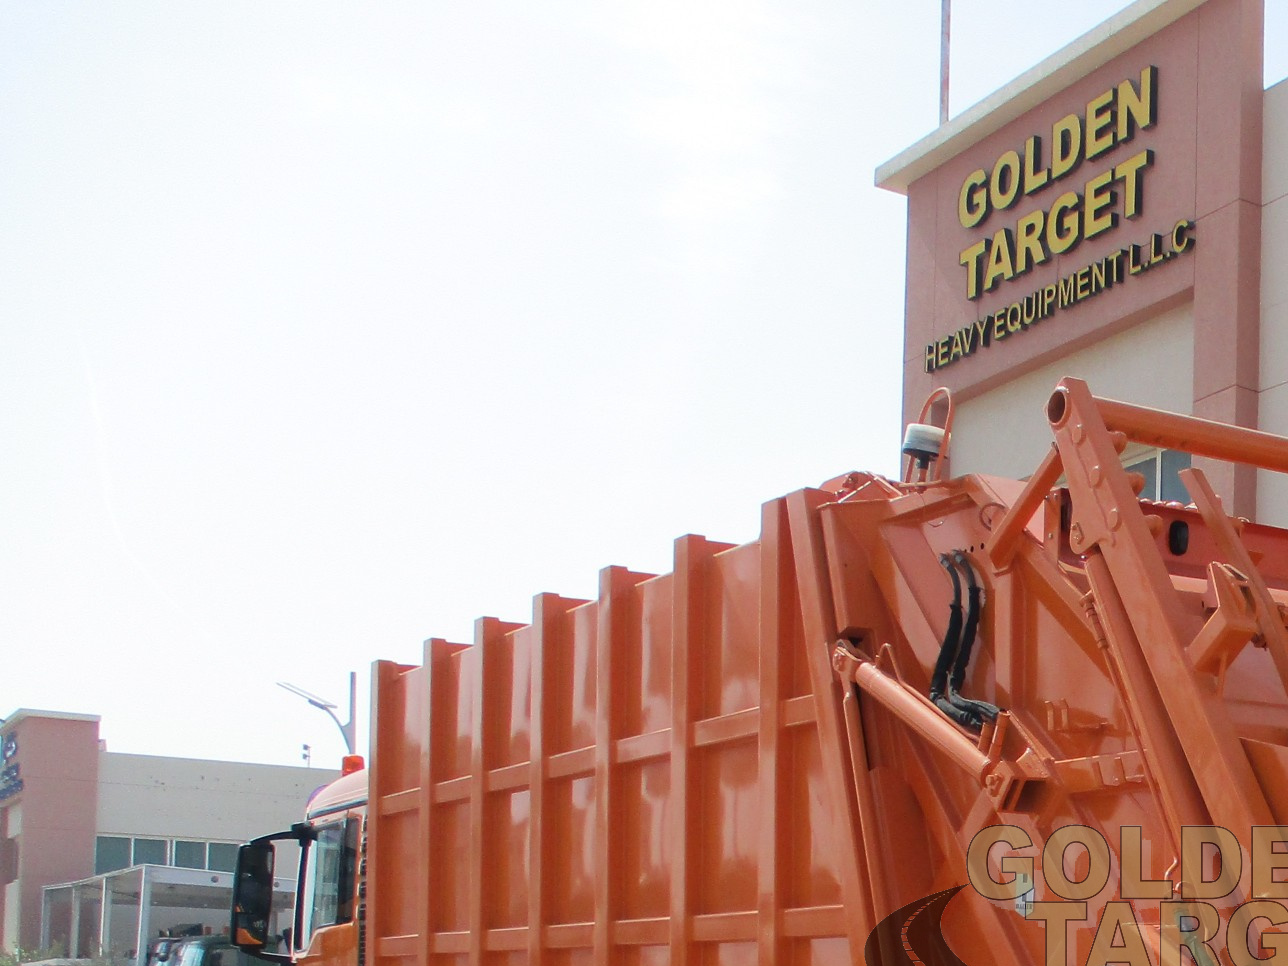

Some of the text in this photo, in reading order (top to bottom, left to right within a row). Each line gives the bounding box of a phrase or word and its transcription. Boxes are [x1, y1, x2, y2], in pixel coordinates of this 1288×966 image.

[958, 65, 1158, 228] GOLDEN
[925, 219, 1196, 373] HEAVY EQUIPMENT L.L.C
[959, 149, 1154, 300] TARGET
